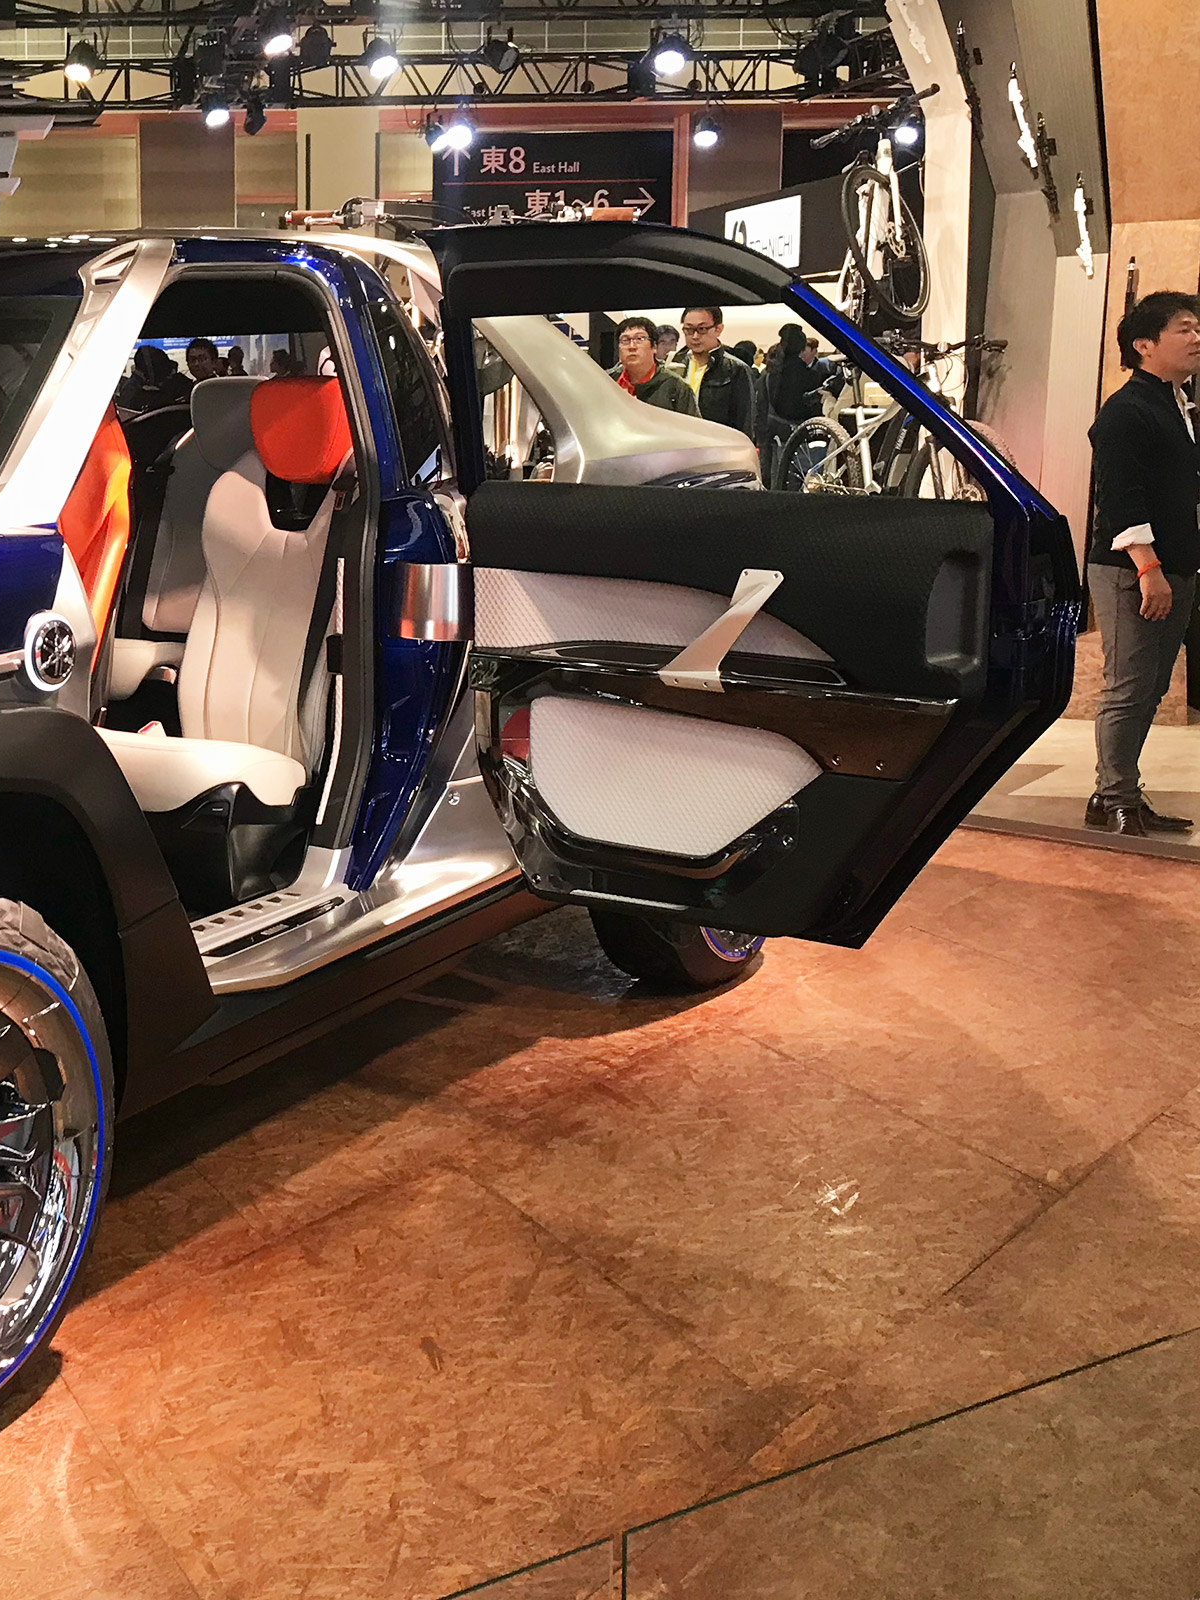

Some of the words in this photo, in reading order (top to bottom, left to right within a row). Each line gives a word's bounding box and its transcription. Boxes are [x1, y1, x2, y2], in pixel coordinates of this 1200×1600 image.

[480, 145, 526, 175] 東8
[532, 161, 555, 174] East
[558, 161, 581, 174] Hall
